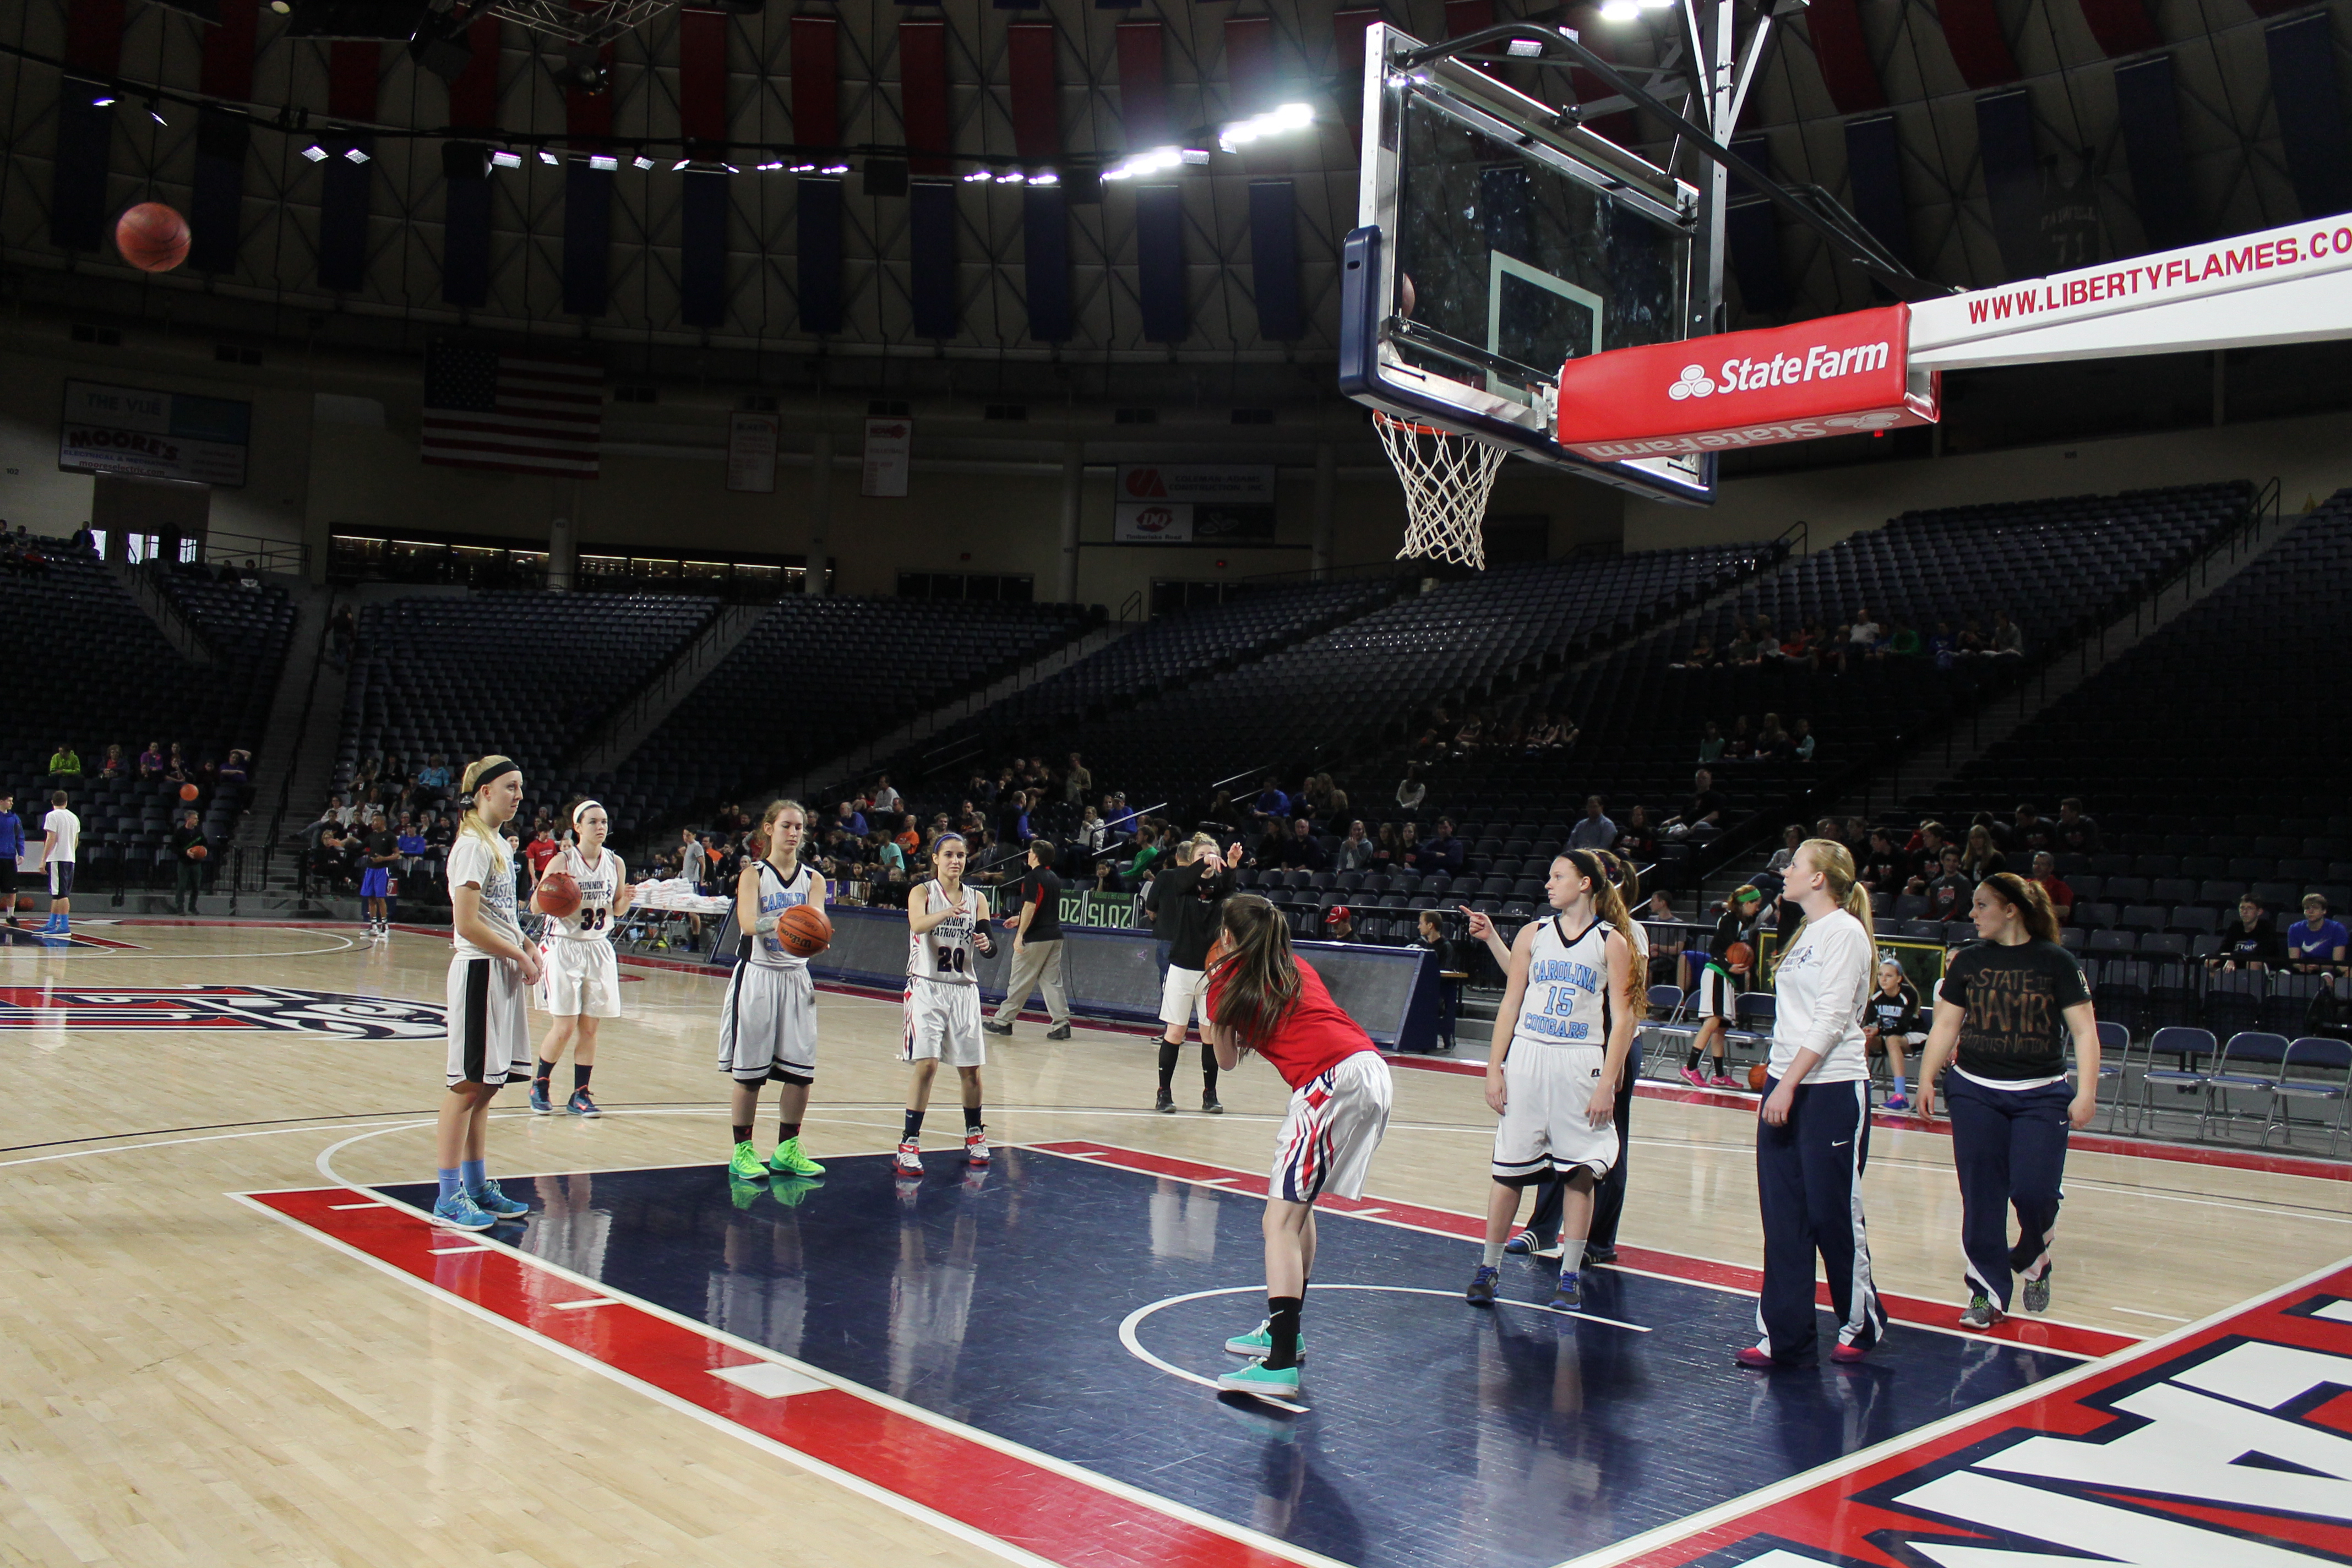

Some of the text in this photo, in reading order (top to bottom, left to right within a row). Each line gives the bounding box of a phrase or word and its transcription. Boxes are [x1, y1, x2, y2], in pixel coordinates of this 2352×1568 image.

[87, 393, 161, 416] THE VUE
[69, 430, 180, 461] MOORE'S
[63, 449, 115, 461] ELECTRICAL
[126, 456, 181, 469] MECHANICAL
[79, 460, 165, 476] mooreselectric.com
[1142, 513, 1168, 525] DQ
[760, 892, 807, 914] CAROLIN
[580, 907, 606, 931] 33
[1087, 902, 1133, 929] 2015
[781, 927, 812, 948] Wilson
[930, 927, 965, 939] PATRIOTS
[937, 946, 965, 973] 20
[1533, 960, 1597, 994] CAROLINA
[1976, 967, 2035, 993] STATE
[1543, 986, 1576, 1017] 15
[1524, 1012, 1589, 1039] COUGARS
